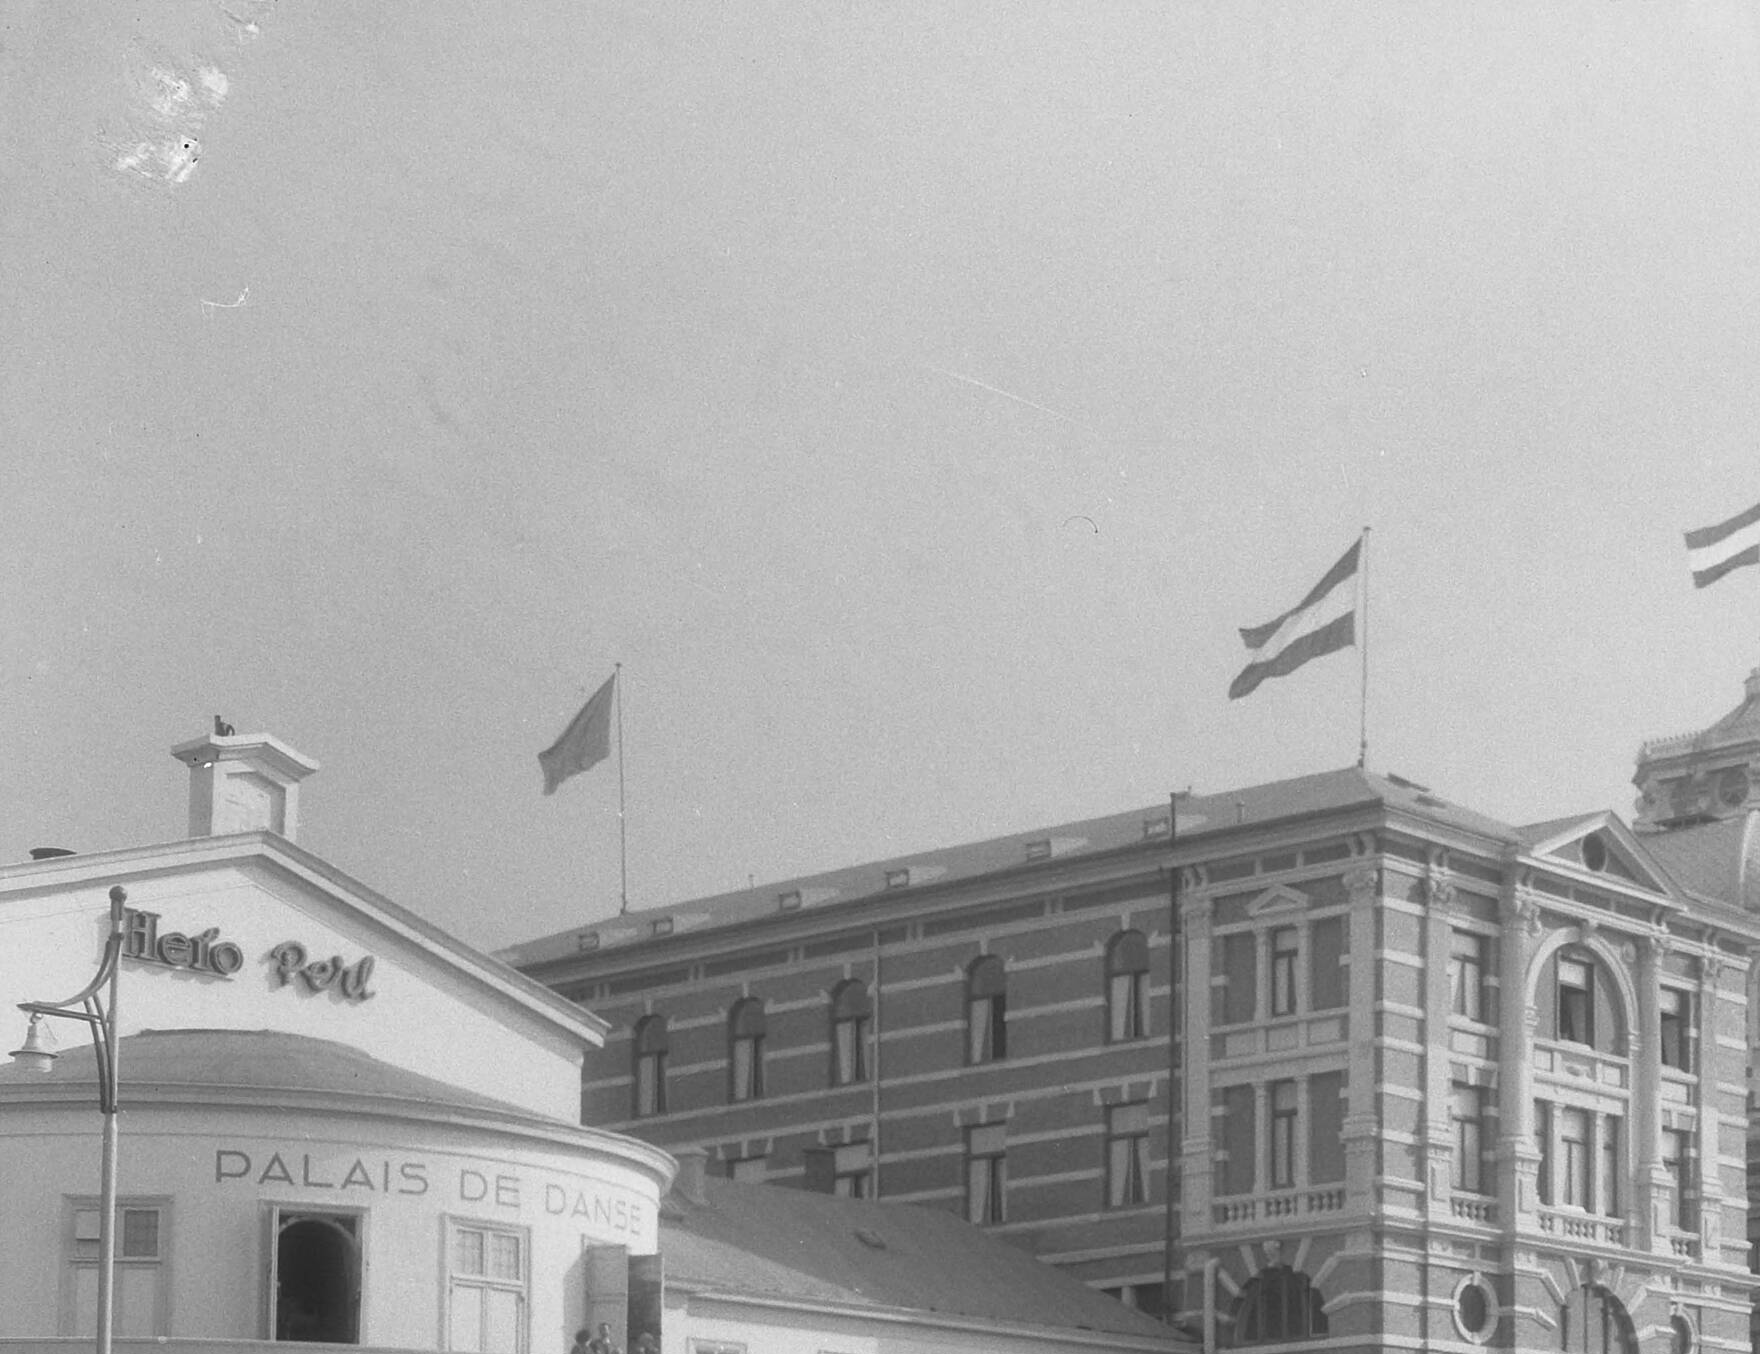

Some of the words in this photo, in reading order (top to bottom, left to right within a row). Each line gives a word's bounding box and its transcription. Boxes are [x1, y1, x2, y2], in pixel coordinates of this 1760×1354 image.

[122, 907, 244, 976] Hero
[215, 1150, 429, 1196] PALAIS
[459, 1168, 521, 1208] DE
[545, 1183, 642, 1237] DANSE
